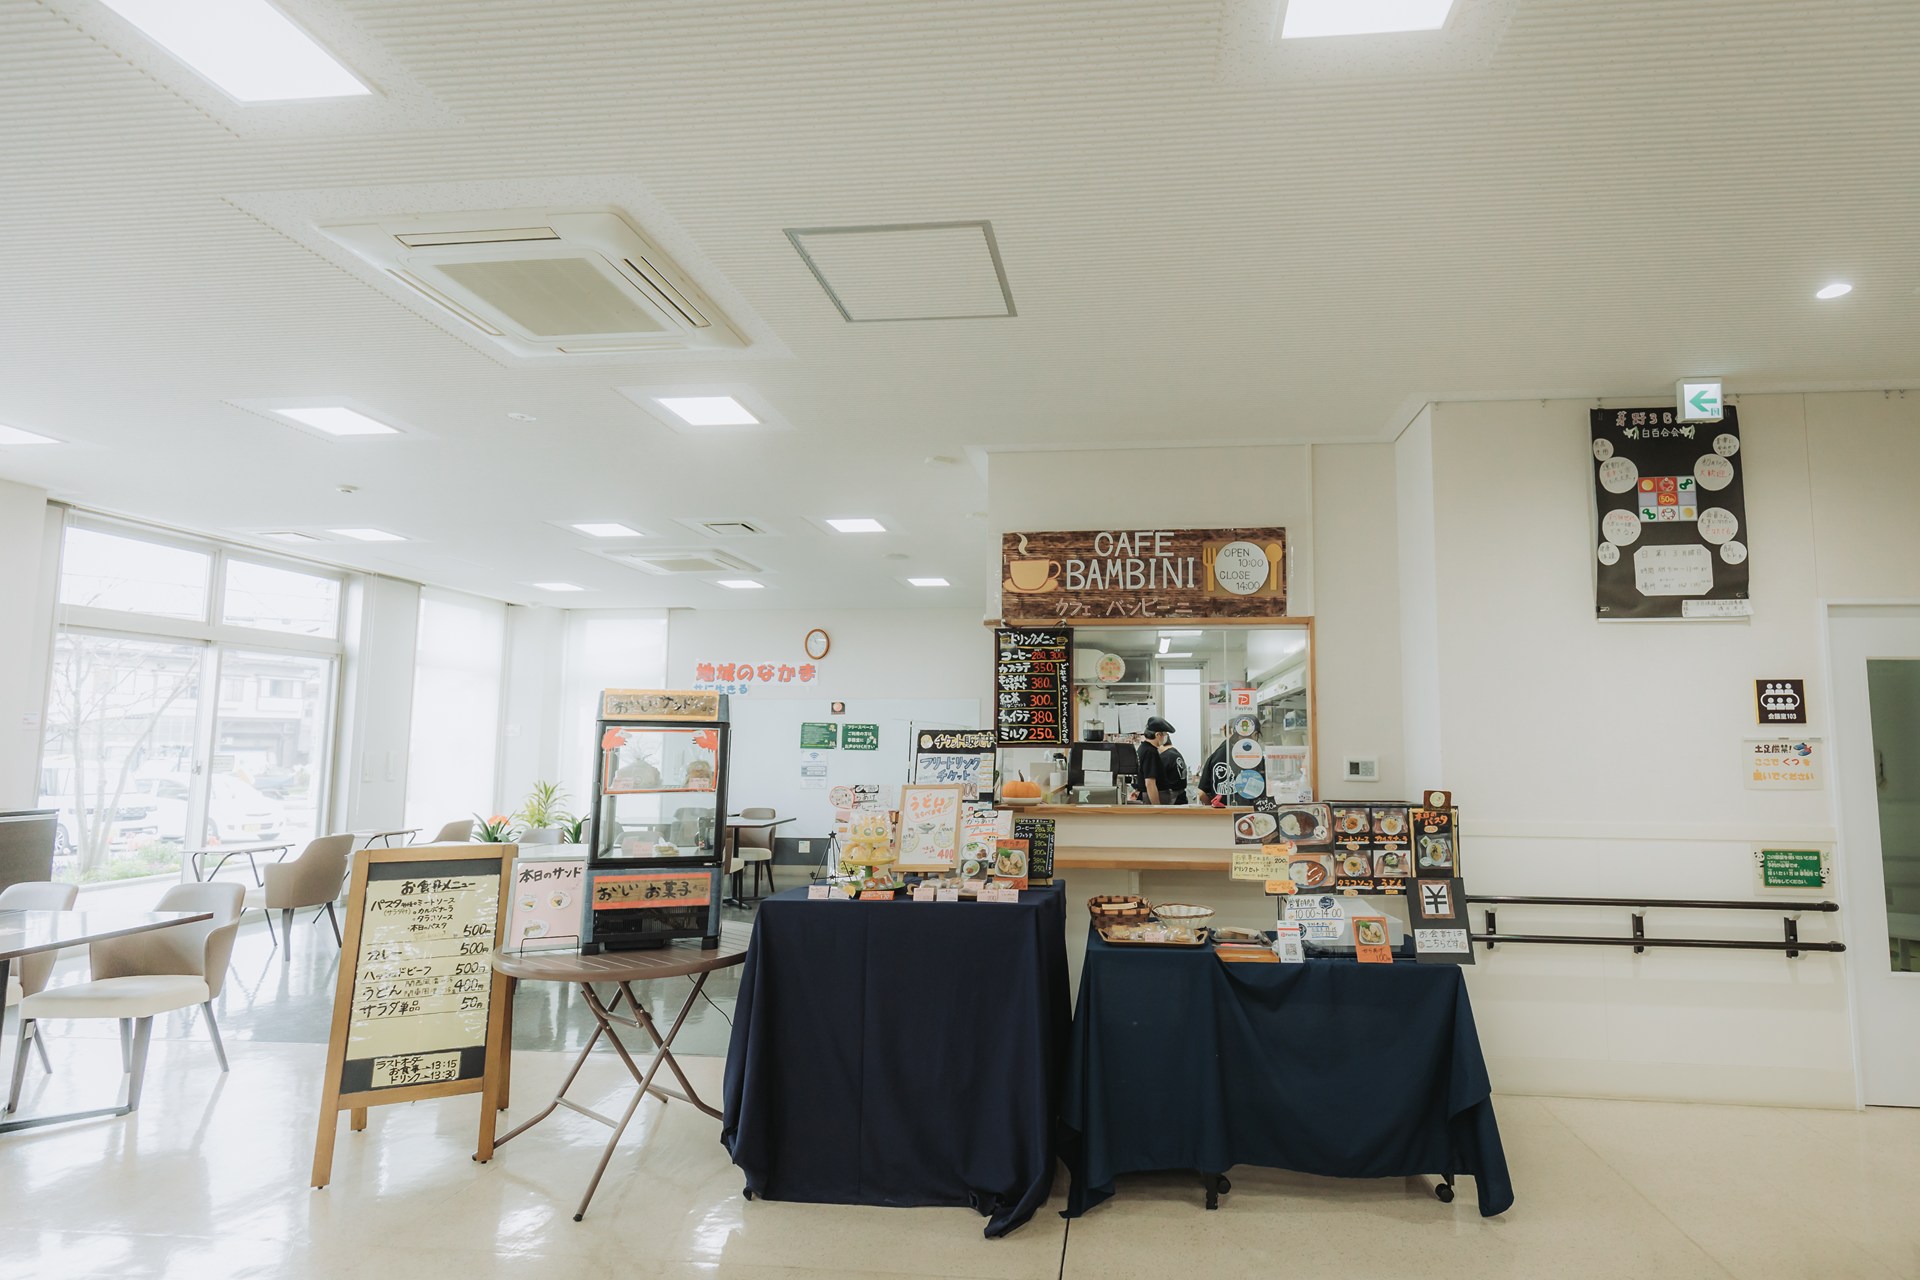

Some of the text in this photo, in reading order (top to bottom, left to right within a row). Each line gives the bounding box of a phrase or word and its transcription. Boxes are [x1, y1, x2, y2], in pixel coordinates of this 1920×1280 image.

[1642, 428, 1681, 438] 白百合会
[1095, 531, 1175, 557] CAFE
[1224, 547, 1250, 557] OPEN
[1238, 558, 1264, 567] 10:00
[1066, 557, 1195, 590] BAMBINI
[1219, 570, 1251, 580] CLOSE
[1236, 581, 1260, 590] 14:00
[1055, 598, 1091, 616] カフェ
[1001, 649, 1032, 661] コーヒー
[696, 662, 816, 683] 地域のなかま
[999, 692, 1021, 703] 紅茶
[934, 731, 995, 749] チケット販売中
[1000, 727, 1029, 740] ミルク
[920, 757, 981, 770] フリードリンク
[1755, 758, 1779, 766] ここで
[1783, 758, 1800, 766] くつ
[937, 769, 970, 782] チケット
[1424, 815, 1448, 826] パスタ
[519, 866, 583, 884] 本日のサンド
[597, 883, 640, 901] おいしい
[644, 880, 691, 899] お菓子
[1419, 930, 1464, 938] お会計は
[367, 949, 403, 961] カレー
[362, 985, 402, 1001] うどん
[359, 1000, 420, 1018] サラダ単品
[376, 1056, 423, 1070] ラストオーダー
[389, 1059, 458, 1076] お食事 13:15
[391, 1069, 456, 1084] ドリンク 13:30
